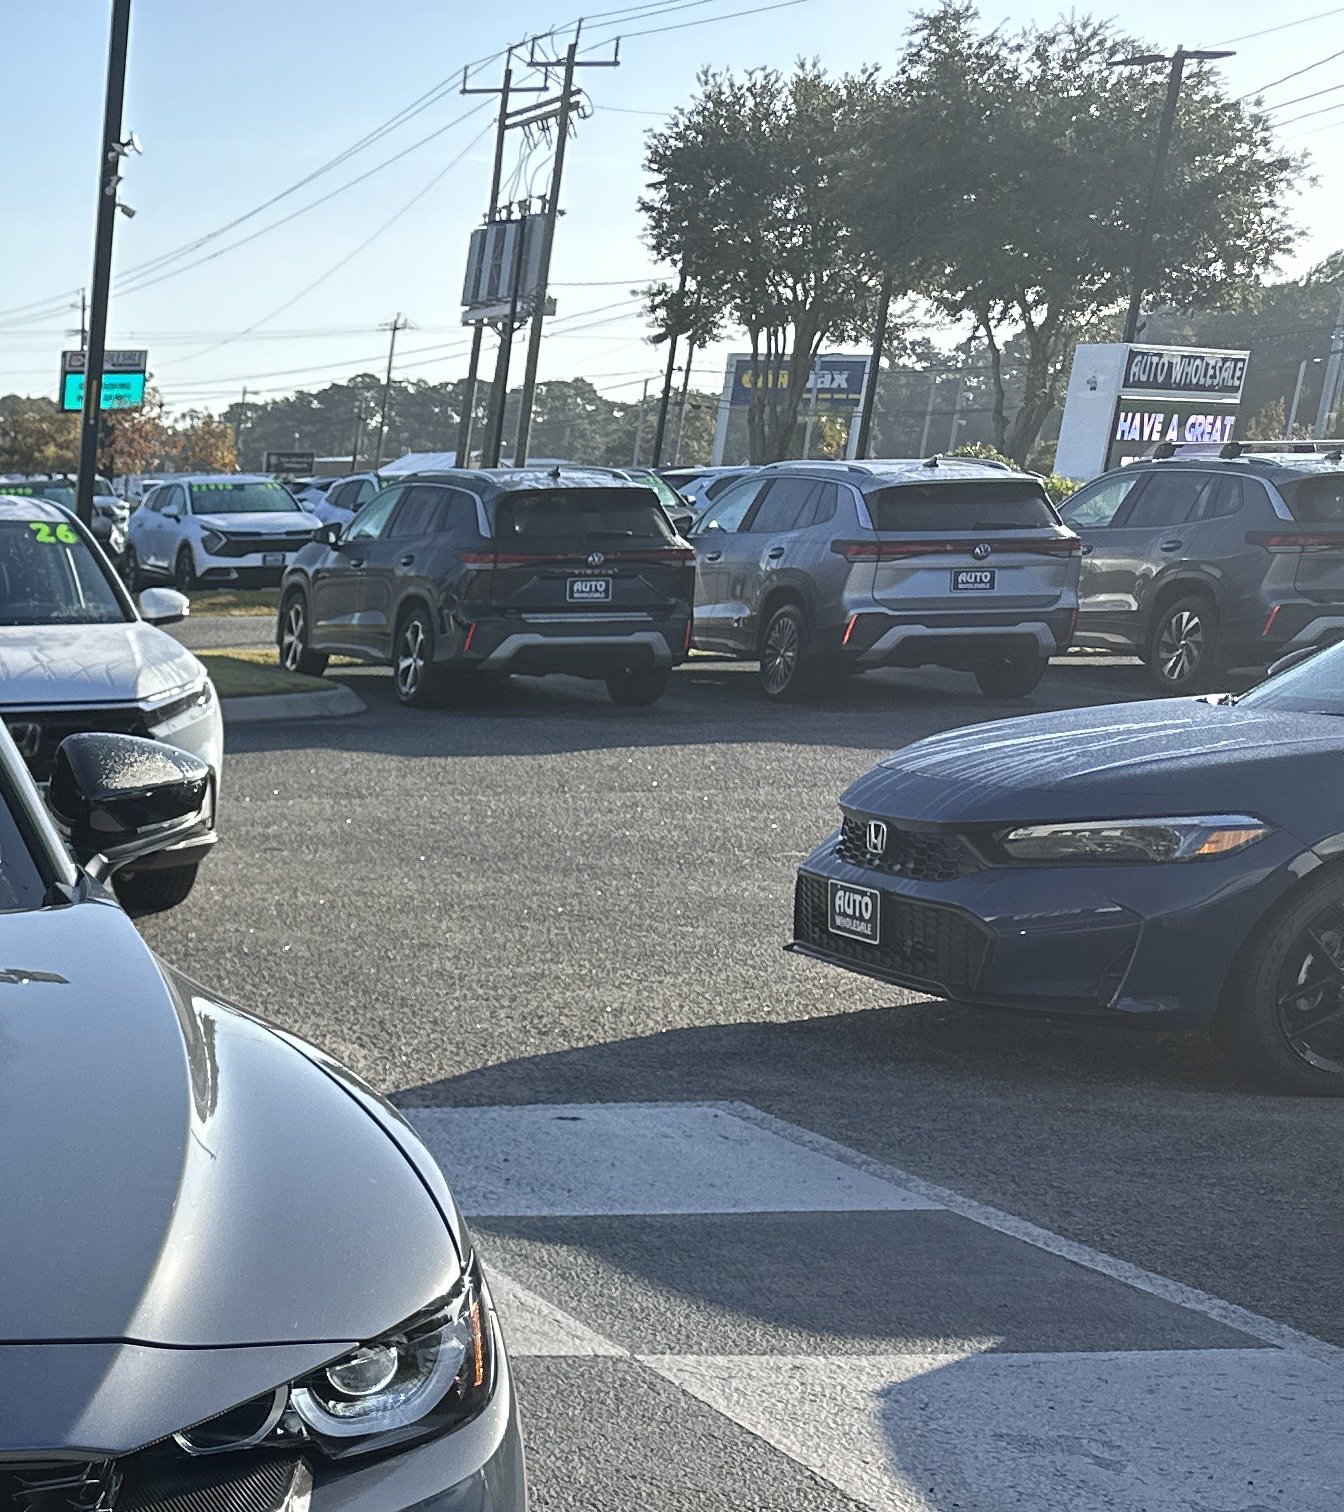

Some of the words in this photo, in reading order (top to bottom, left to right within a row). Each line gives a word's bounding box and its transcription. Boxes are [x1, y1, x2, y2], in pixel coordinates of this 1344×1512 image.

[1129, 354, 1169, 383] AUTO
[1170, 356, 1244, 387] WHOLESALE
[1116, 412, 1164, 441] HAVE
[1165, 413, 1179, 441] A
[1184, 414, 1235, 442] GREAT
[28, 521, 79, 544] 26
[573, 581, 606, 592] AUTO
[958, 572, 991, 583] AUTO
[835, 890, 873, 920] AUTO
[835, 914, 872, 935] WHOLESALE
